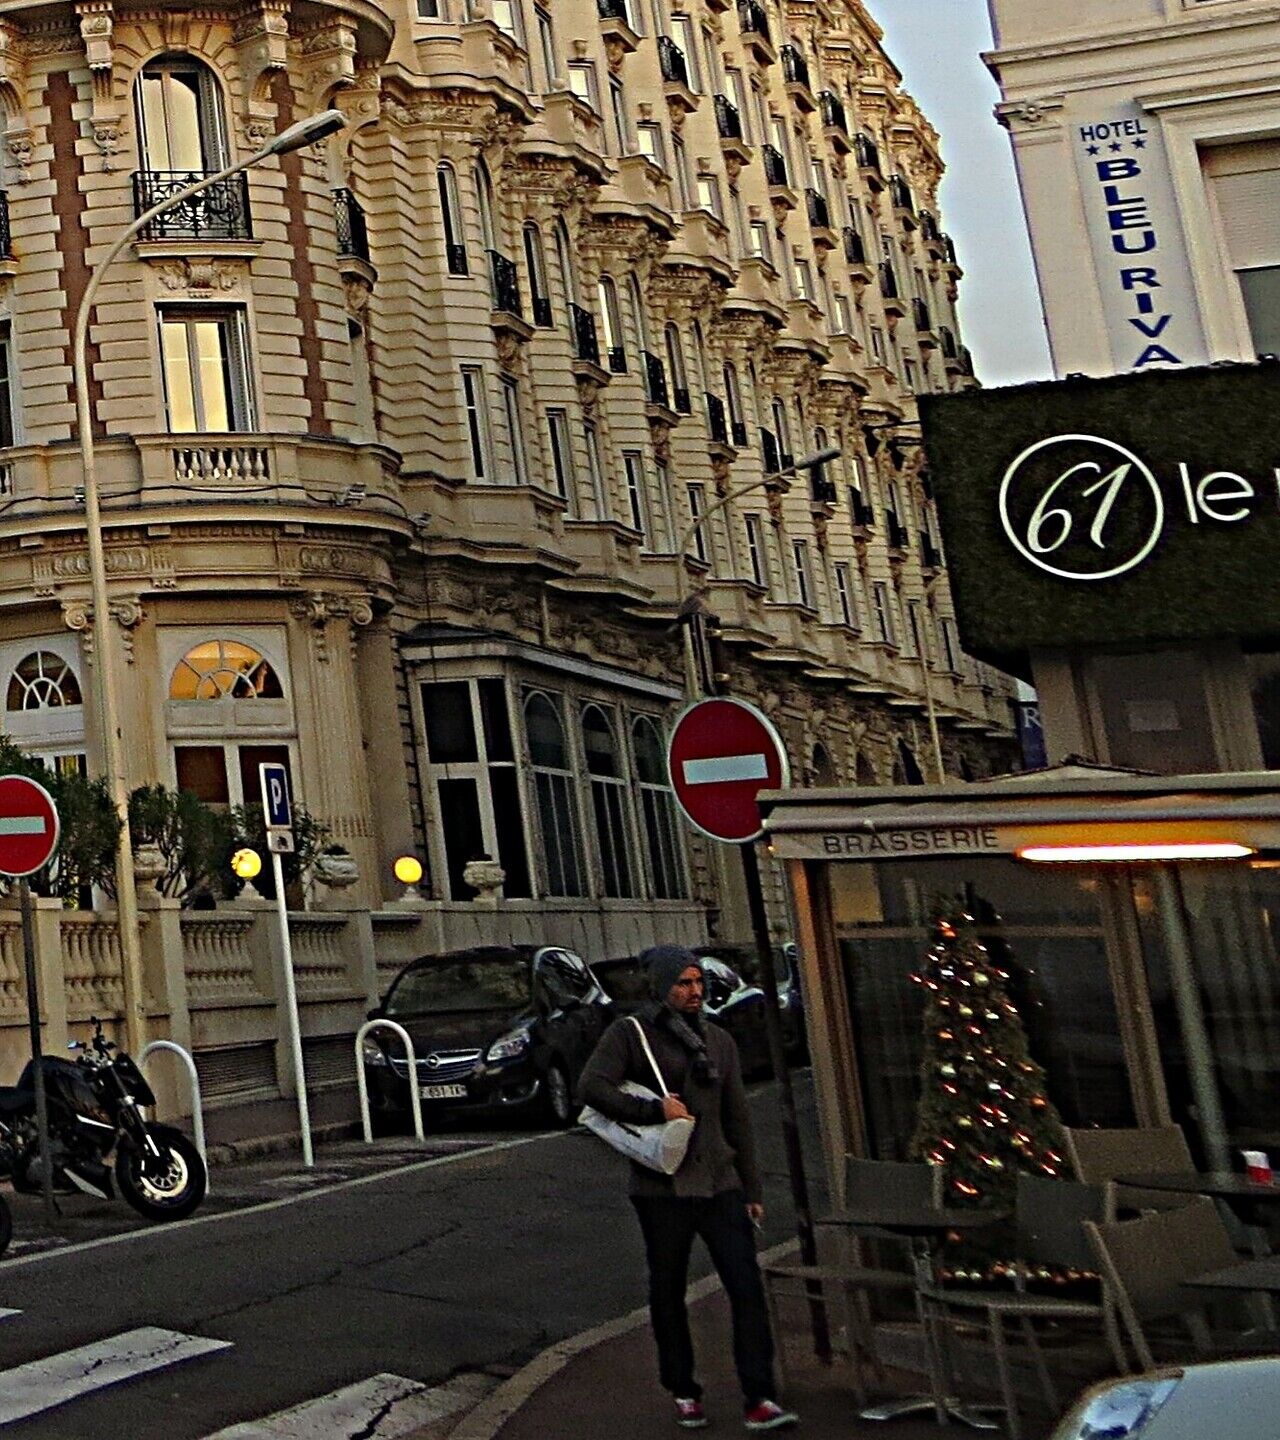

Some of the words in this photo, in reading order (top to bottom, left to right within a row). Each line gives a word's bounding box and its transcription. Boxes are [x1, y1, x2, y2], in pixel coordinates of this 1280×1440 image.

[1080, 118, 1149, 142] HOTEL
[1095, 157, 1157, 255] BLEU
[1120, 266, 1184, 368] RIVA
[1026, 461, 1133, 553] 61
[1178, 462, 1255, 524] le
[270, 778, 282, 816] P
[823, 828, 999, 854] BRASSERIE
